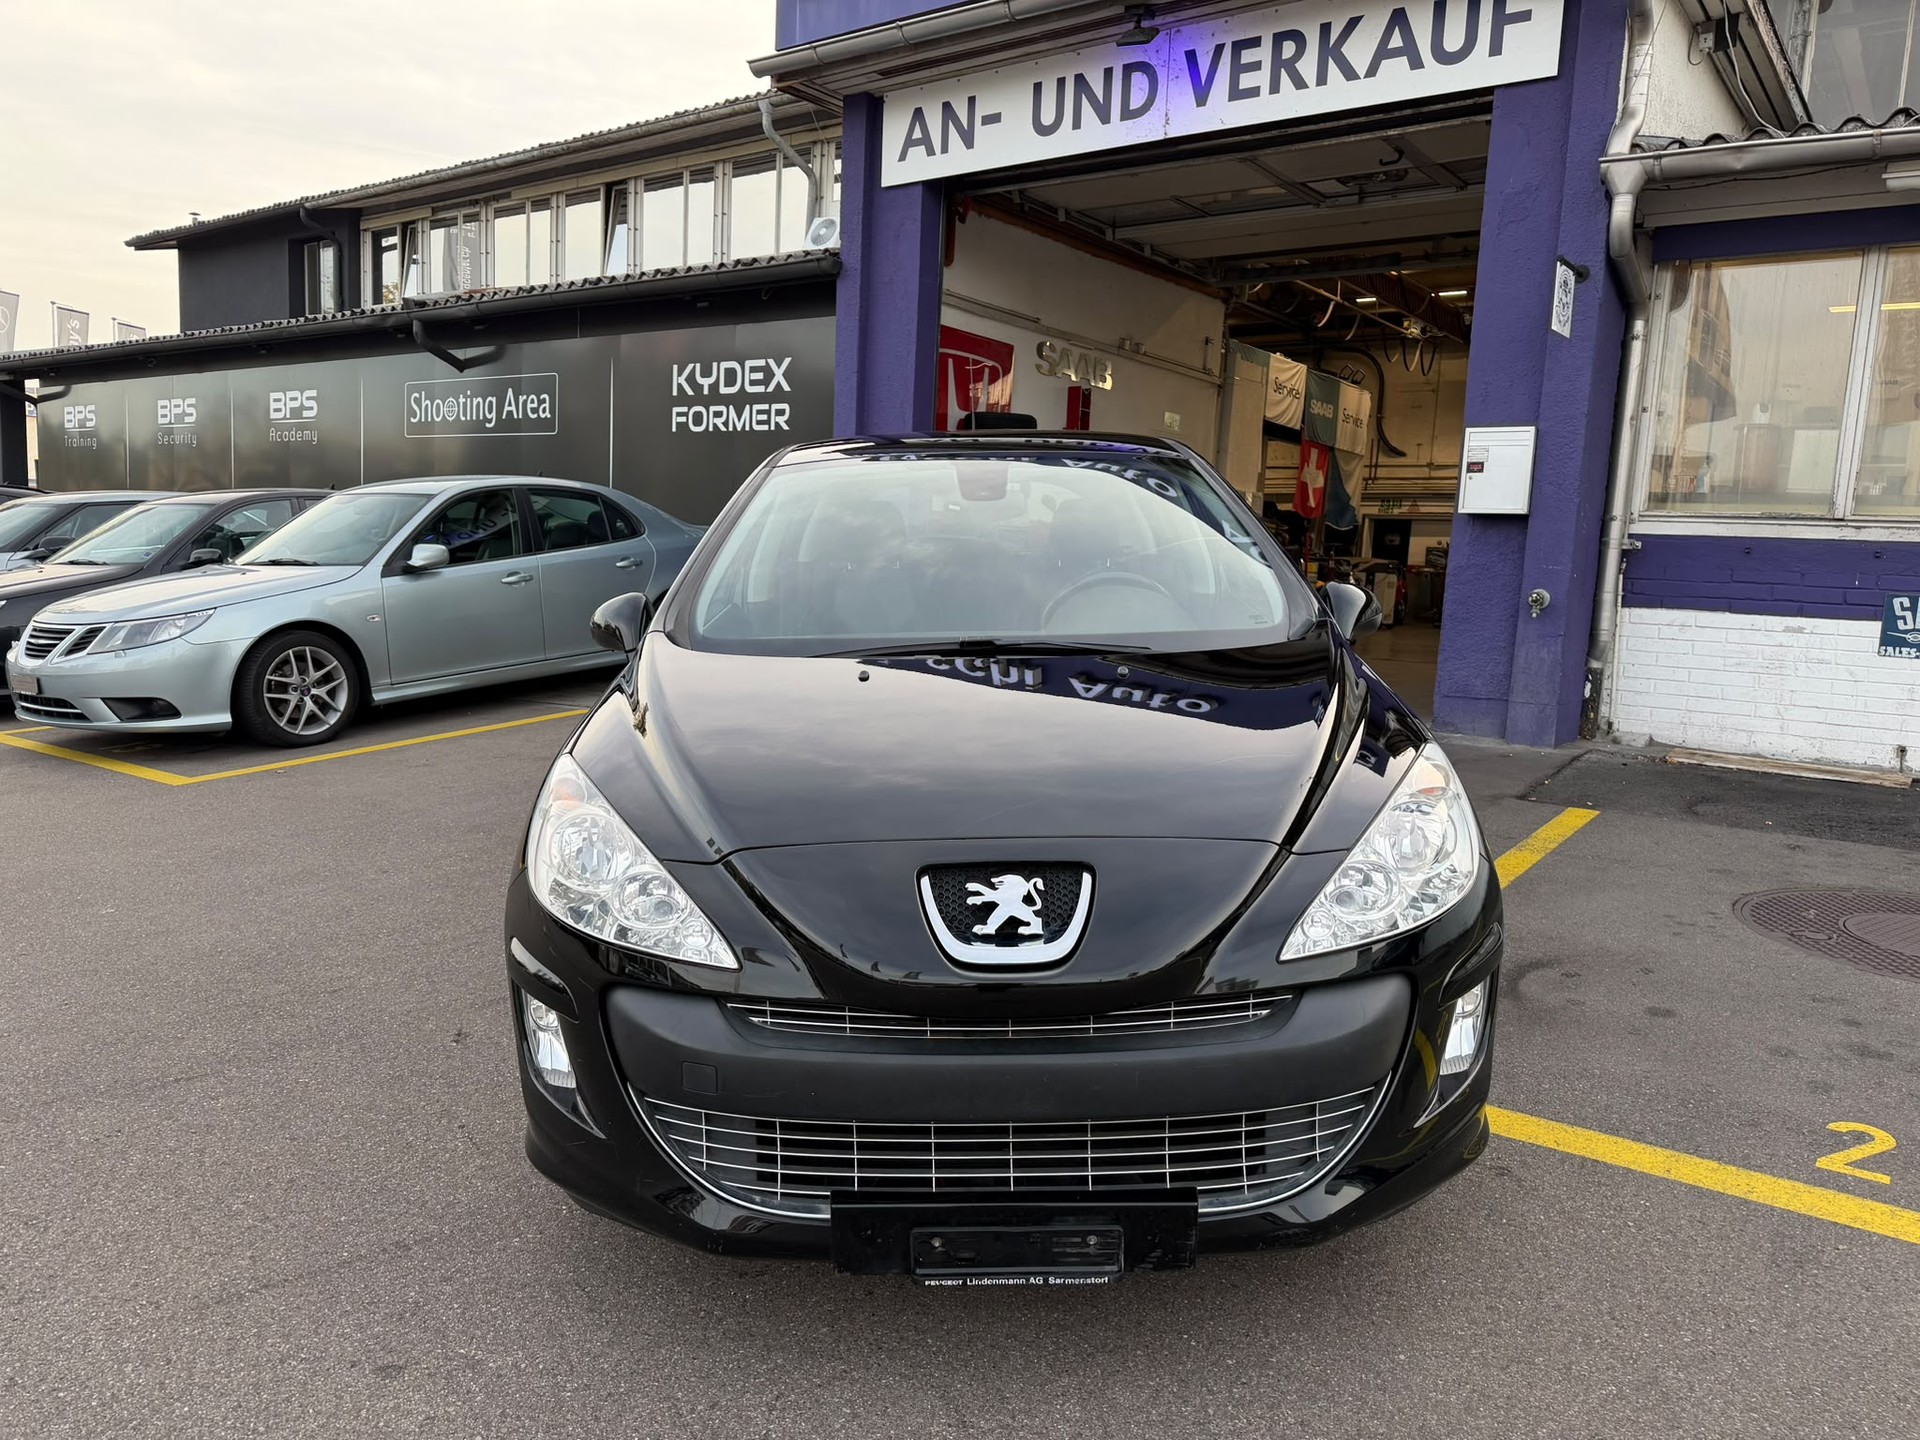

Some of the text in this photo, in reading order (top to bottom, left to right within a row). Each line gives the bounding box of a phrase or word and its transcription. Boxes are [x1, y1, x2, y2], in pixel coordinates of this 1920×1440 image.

[897, 0, 1533, 162] AN- UND VERKAUF
[672, 357, 793, 397] KYDEX
[1035, 340, 1113, 391] SAAB
[1273, 376, 1300, 399] Service
[63, 404, 96, 429] BPS
[157, 397, 197, 425] BPS
[269, 389, 318, 419] BPS
[409, 387, 551, 428] Shooting Area
[671, 403, 790, 433] FORMER
[1310, 399, 1363, 428] SAAB Service
[64, 435, 98, 449] Training
[157, 432, 198, 448] Security
[269, 427, 318, 445] Academy
[1892, 596, 1920, 631] S
[1815, 1121, 1897, 1185] 2
[967, 1277, 1026, 1285] Lindenmann
[1028, 1276, 1044, 1284] AG
[1048, 1276, 1109, 1285] Sarmenstorf
